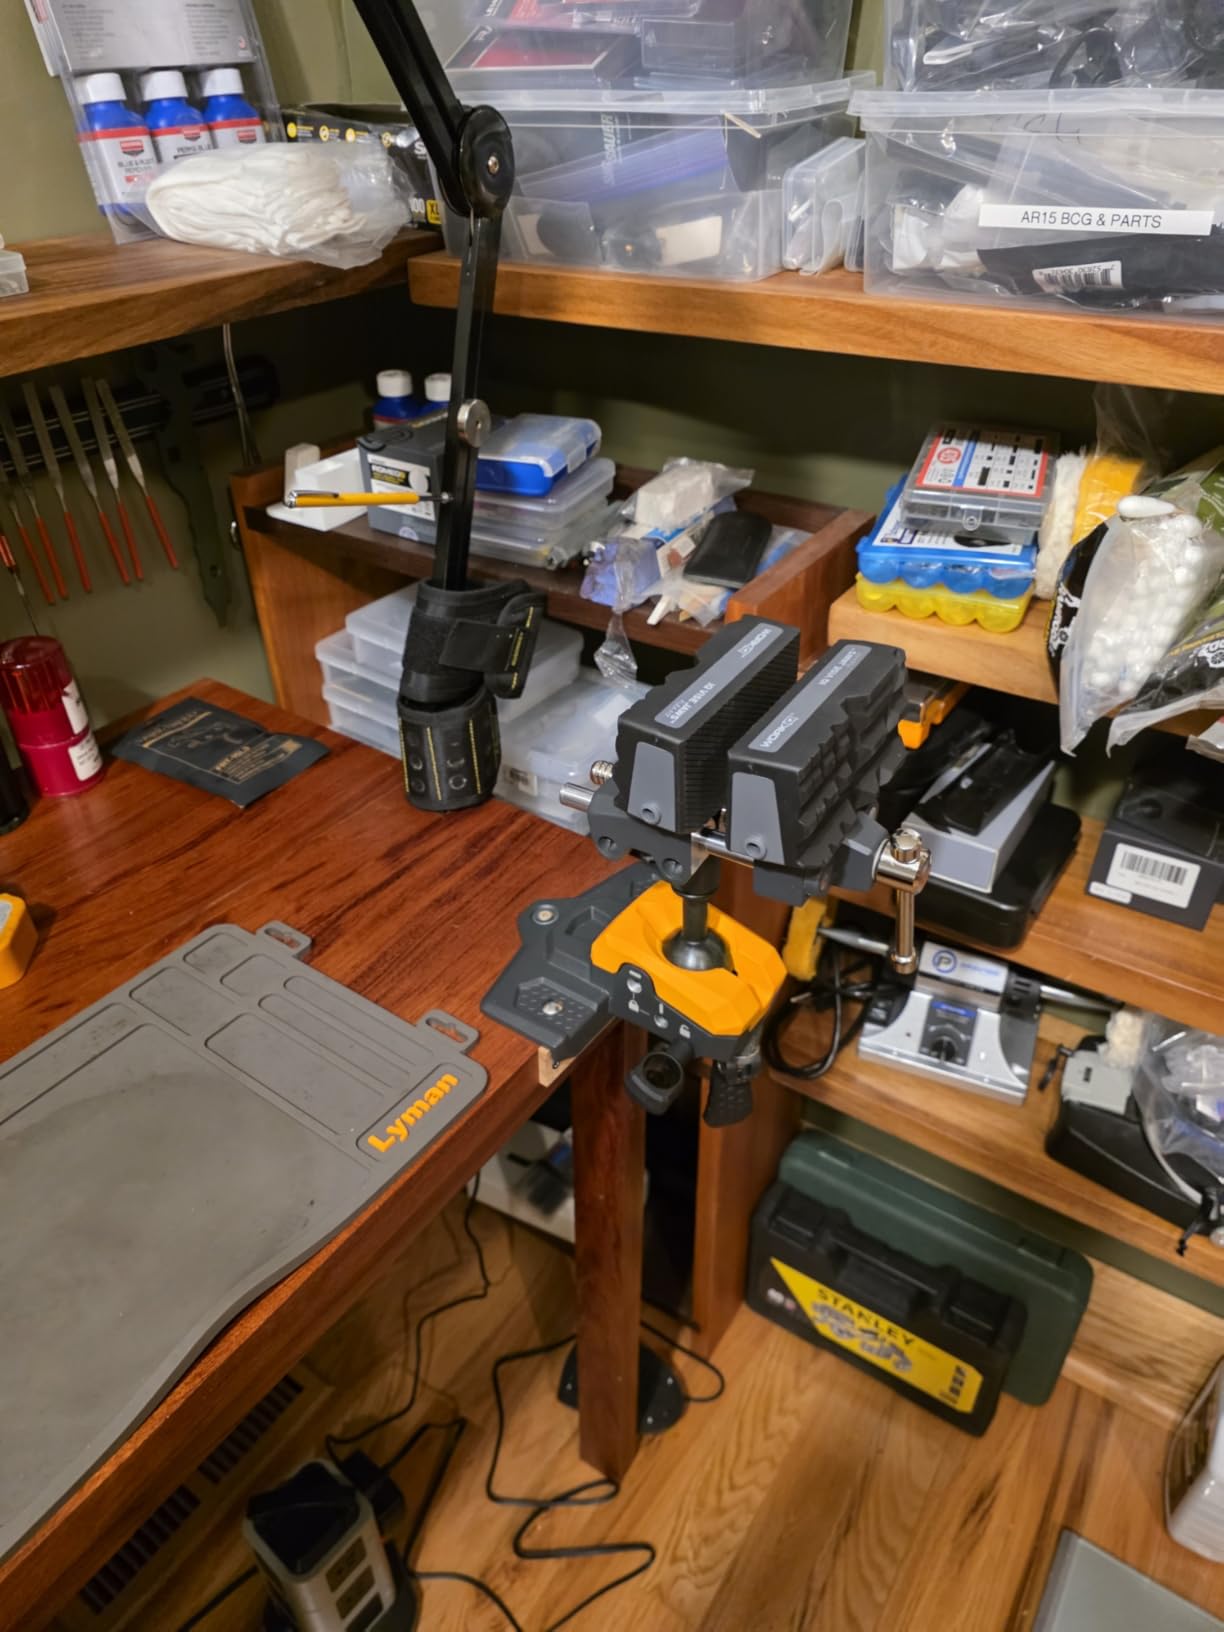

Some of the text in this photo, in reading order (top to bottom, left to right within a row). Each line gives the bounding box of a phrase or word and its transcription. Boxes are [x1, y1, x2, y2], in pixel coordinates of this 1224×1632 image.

[1020, 210, 1162, 228] AR15 BCG & PARTS
[367, 1073, 459, 1153] Lyman
[817, 1287, 917, 1346] STANLEY
